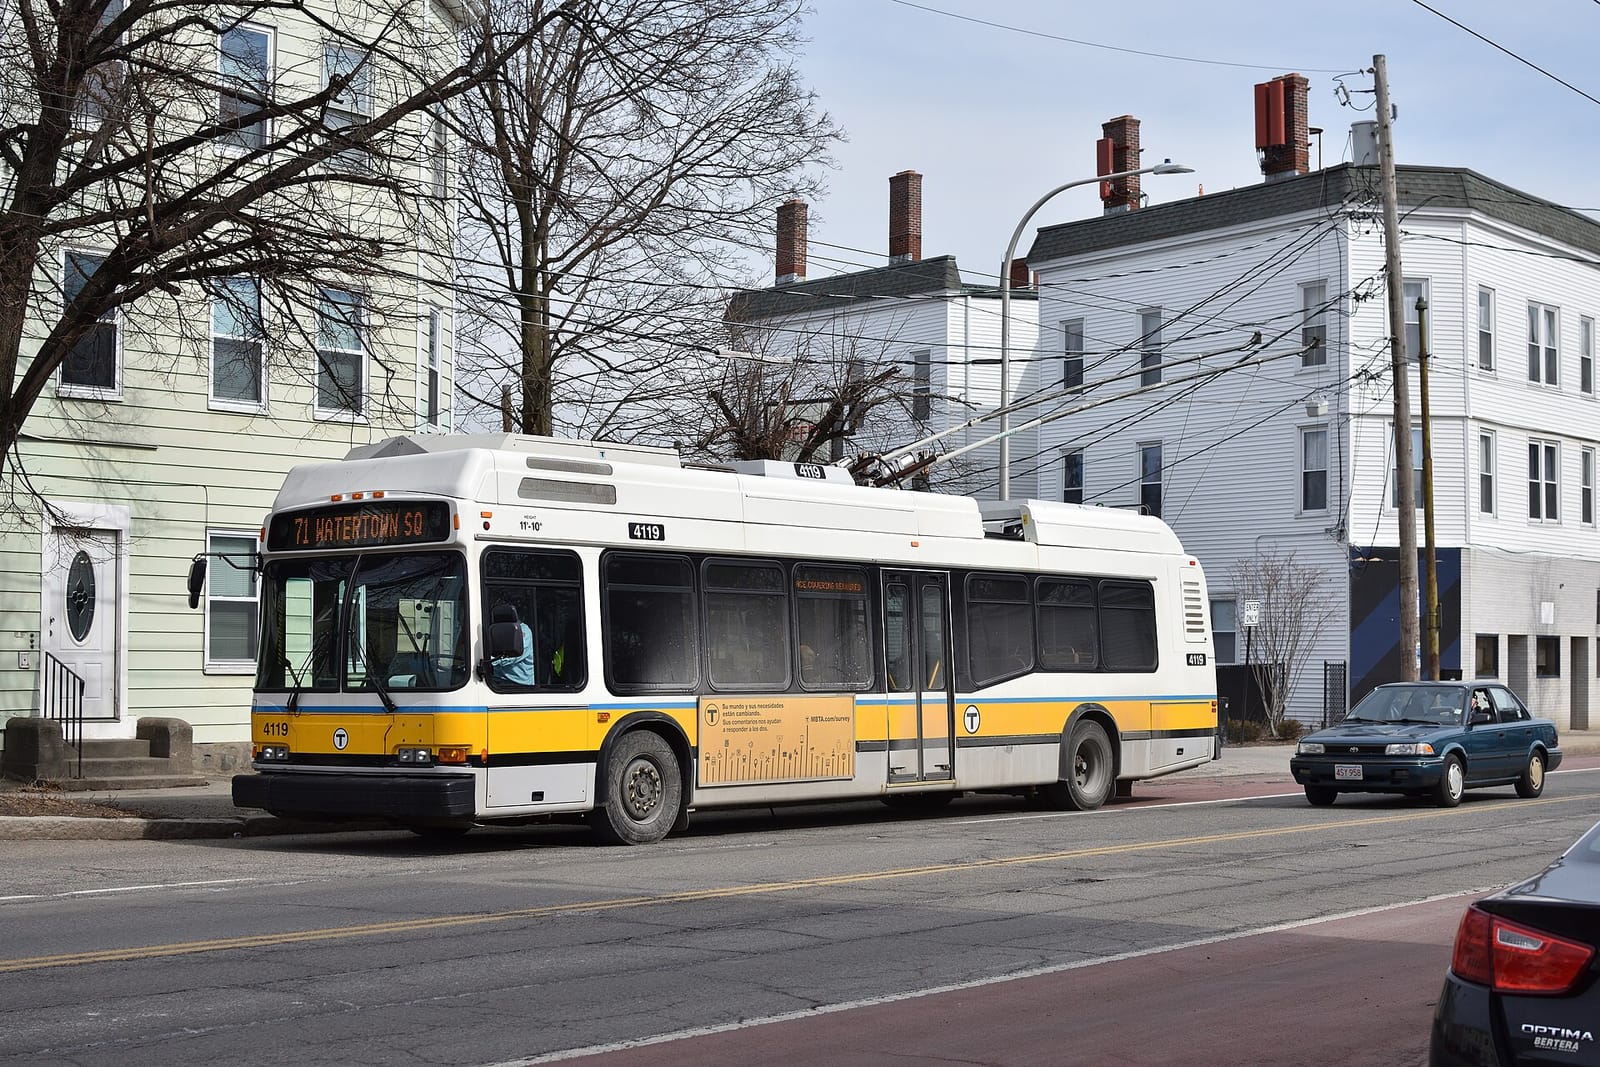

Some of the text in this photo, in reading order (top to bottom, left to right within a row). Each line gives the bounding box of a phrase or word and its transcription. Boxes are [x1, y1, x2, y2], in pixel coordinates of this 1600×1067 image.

[799, 464, 821, 478] 4119
[294, 511, 424, 545] 71 WATERTOWN SQ
[633, 525, 660, 539] 4119
[1246, 614, 1258, 623] ONLY
[1188, 654, 1204, 665] 4119
[810, 715, 850, 723] MBTA.com/survey
[263, 722, 288, 737] 4119
[1521, 1023, 1594, 1042] OPTIMA
[1533, 1036, 1579, 1051] BERTERA
